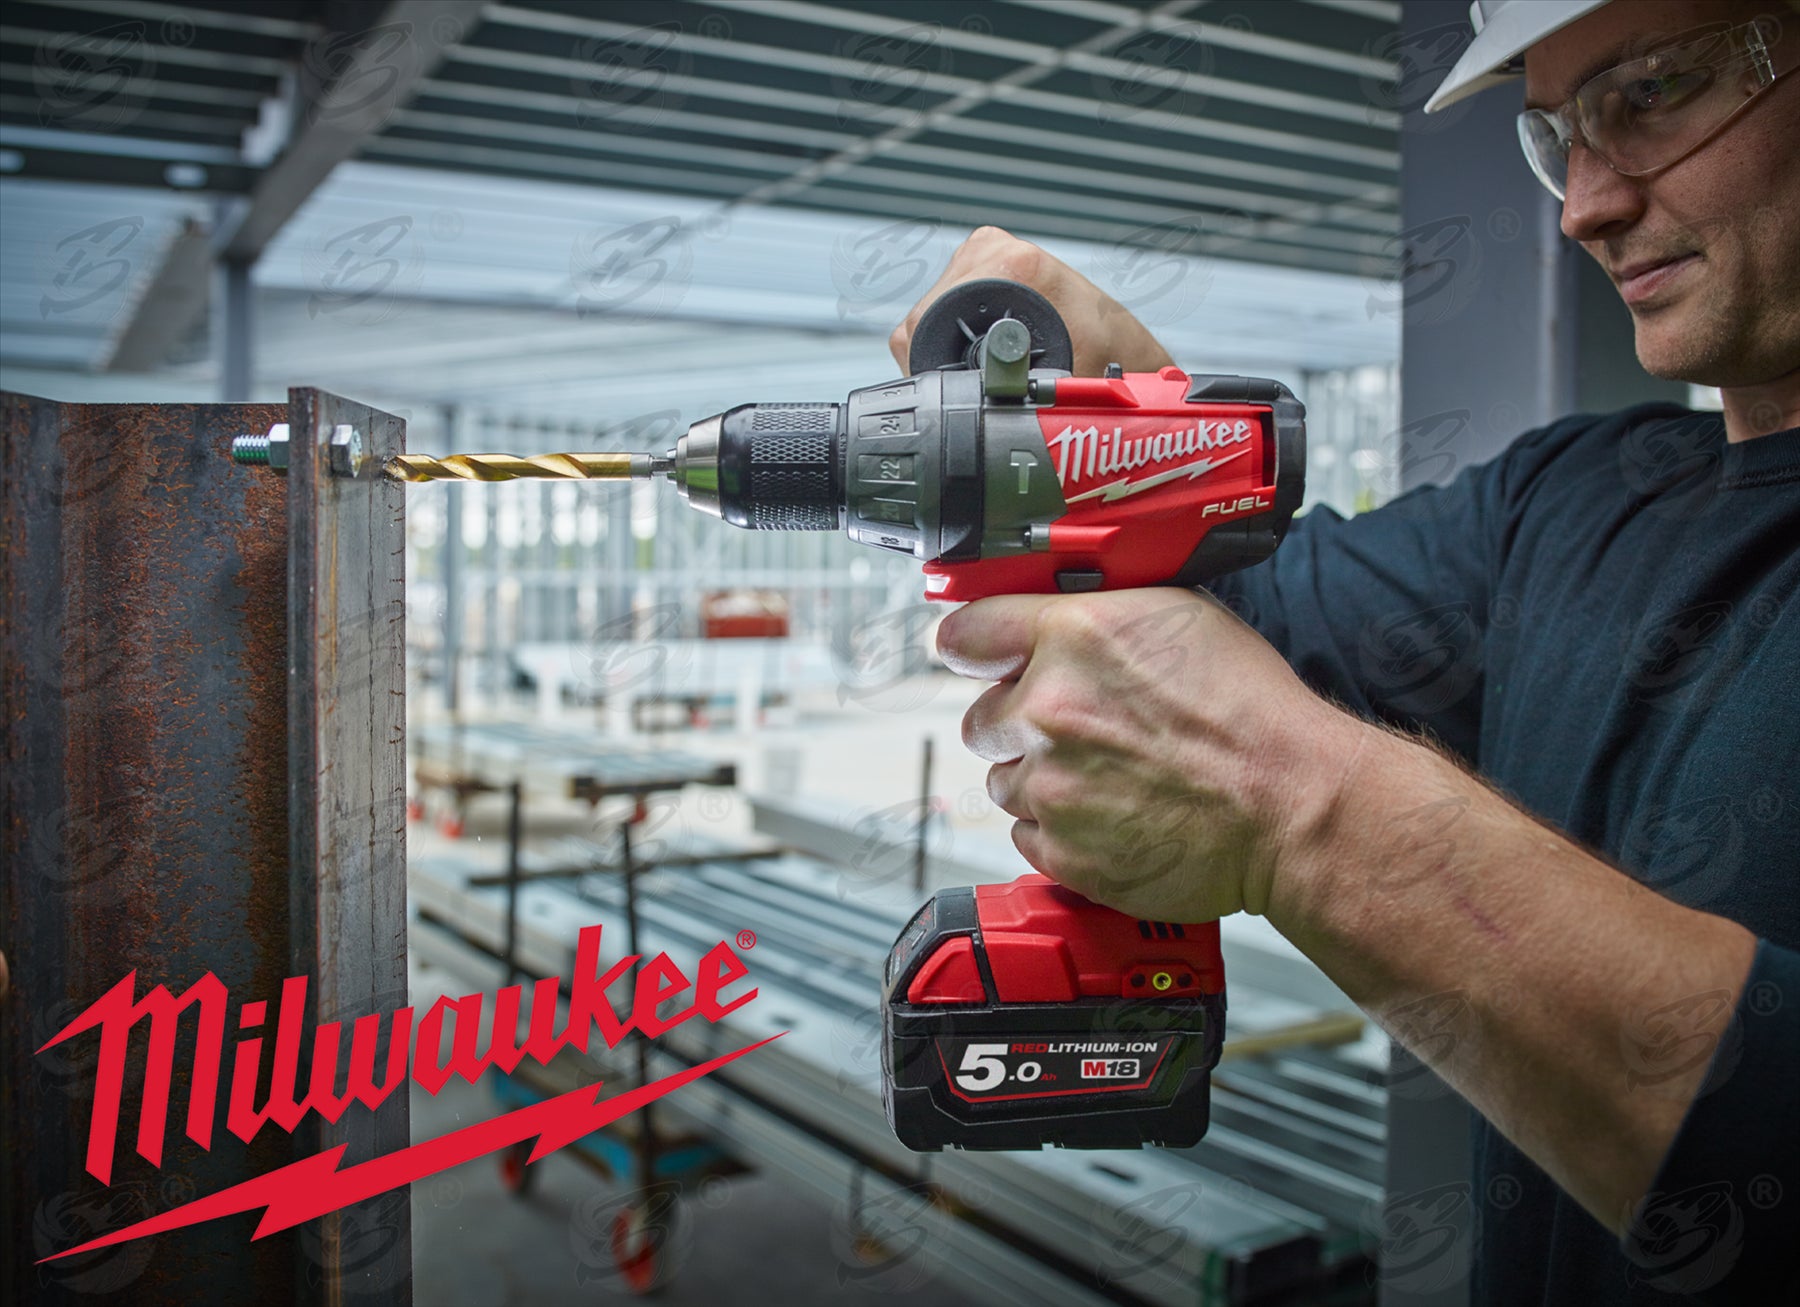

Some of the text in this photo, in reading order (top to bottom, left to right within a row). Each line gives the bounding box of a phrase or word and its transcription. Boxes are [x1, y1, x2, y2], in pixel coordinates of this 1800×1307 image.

[880, 415, 900, 434] 24
[1046, 420, 1253, 489] Milwaukee
[880, 459, 901, 480] 22
[1201, 495, 1270, 519] FUEL
[1010, 1042, 1158, 1055] REDLITHIUM-ION
[1083, 1060, 1139, 1077] M18
